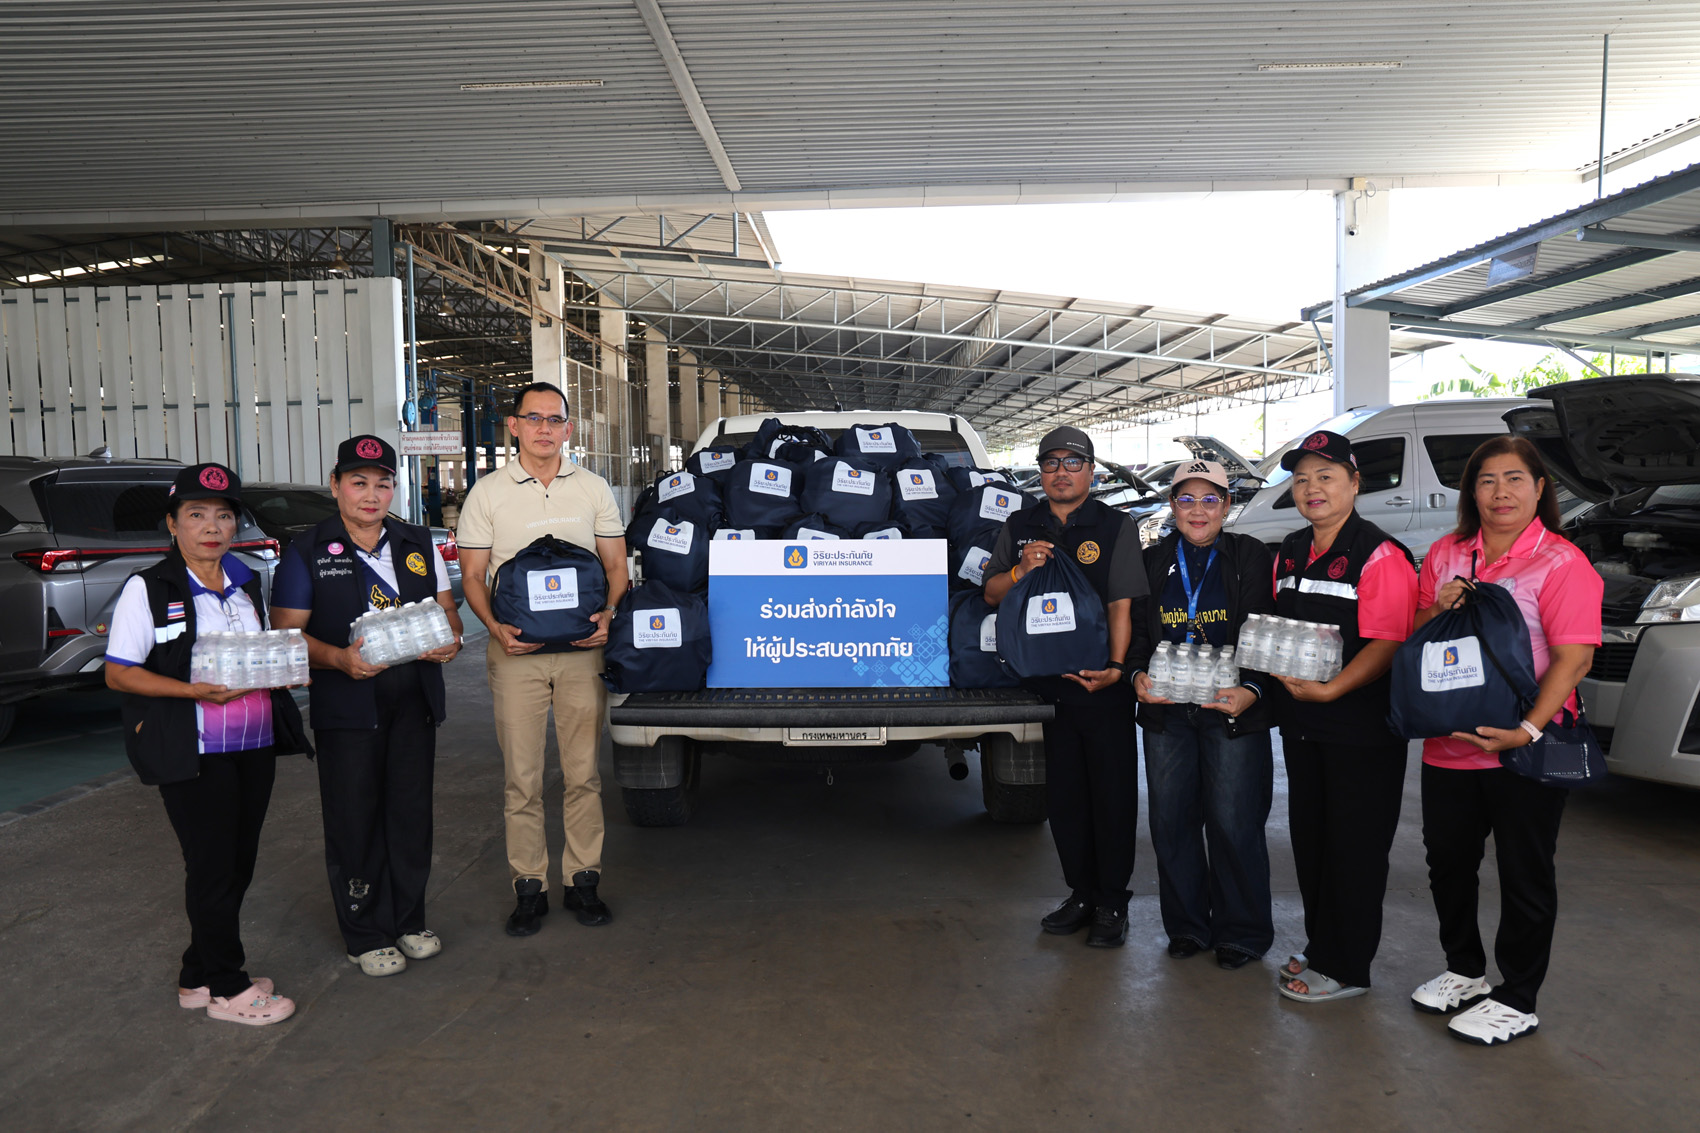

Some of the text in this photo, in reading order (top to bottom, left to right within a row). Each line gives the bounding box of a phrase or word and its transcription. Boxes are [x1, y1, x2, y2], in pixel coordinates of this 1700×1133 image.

[549, 516, 581, 524] INSURANCE
[813, 550, 873, 560] วิริยะประกันภัย
[759, 597, 897, 619] ร่วมส่งกำลังใจ
[744, 635, 914, 664] ให้ผู้ประสบอุทกภัย
[802, 732, 868, 740] กรงเทพมหานคร
